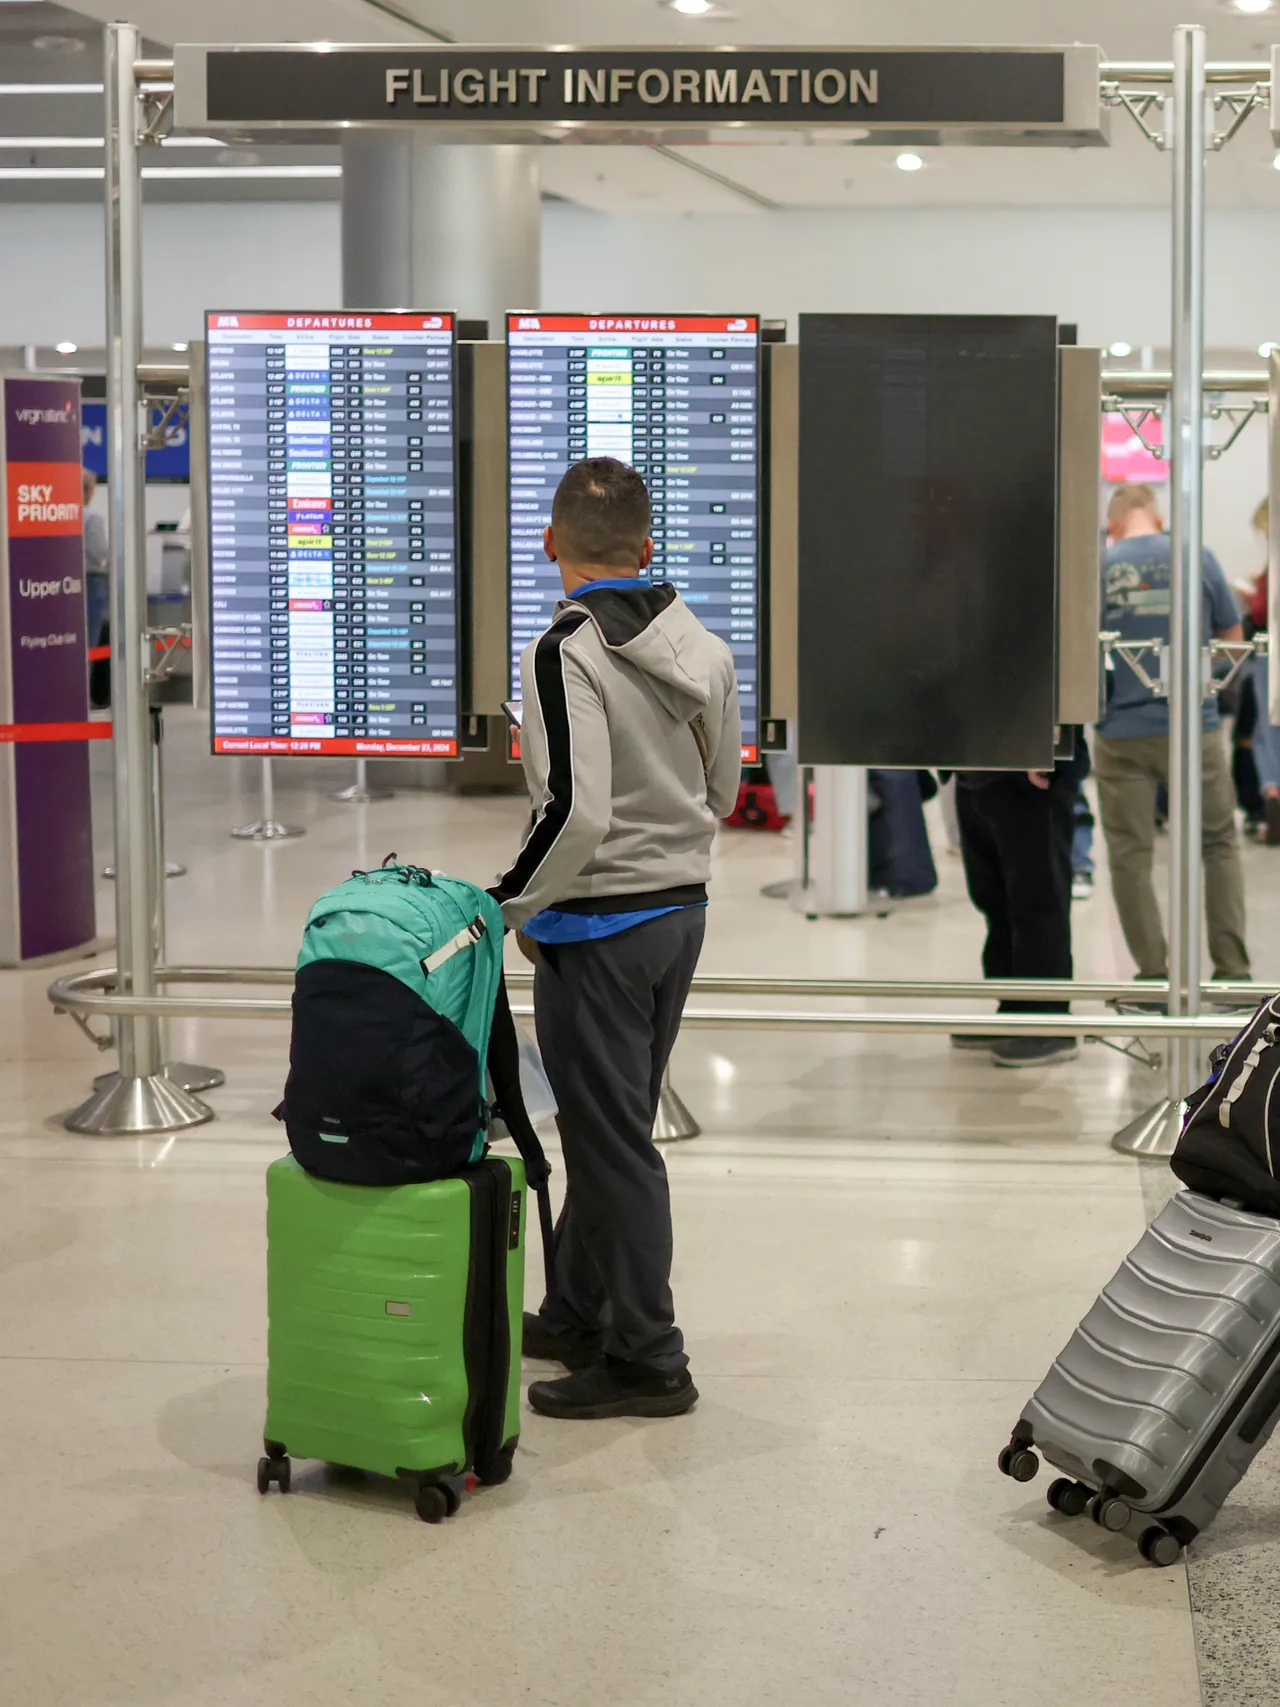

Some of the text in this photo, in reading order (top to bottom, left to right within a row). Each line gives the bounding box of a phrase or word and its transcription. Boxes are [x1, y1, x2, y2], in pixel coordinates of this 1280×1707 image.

[383, 68, 881, 106] FLIGHT INFORMATION
[287, 317, 373, 329] DEPARTURES
[588, 319, 676, 330] DEPARTURES
[295, 410, 321, 418] DELTA
[17, 484, 53, 503] SKY
[292, 498, 326, 509] Emirates
[20, 578, 61, 599] Upper
[356, 742, 385, 752] Monday,
[386, 742, 420, 751] December
